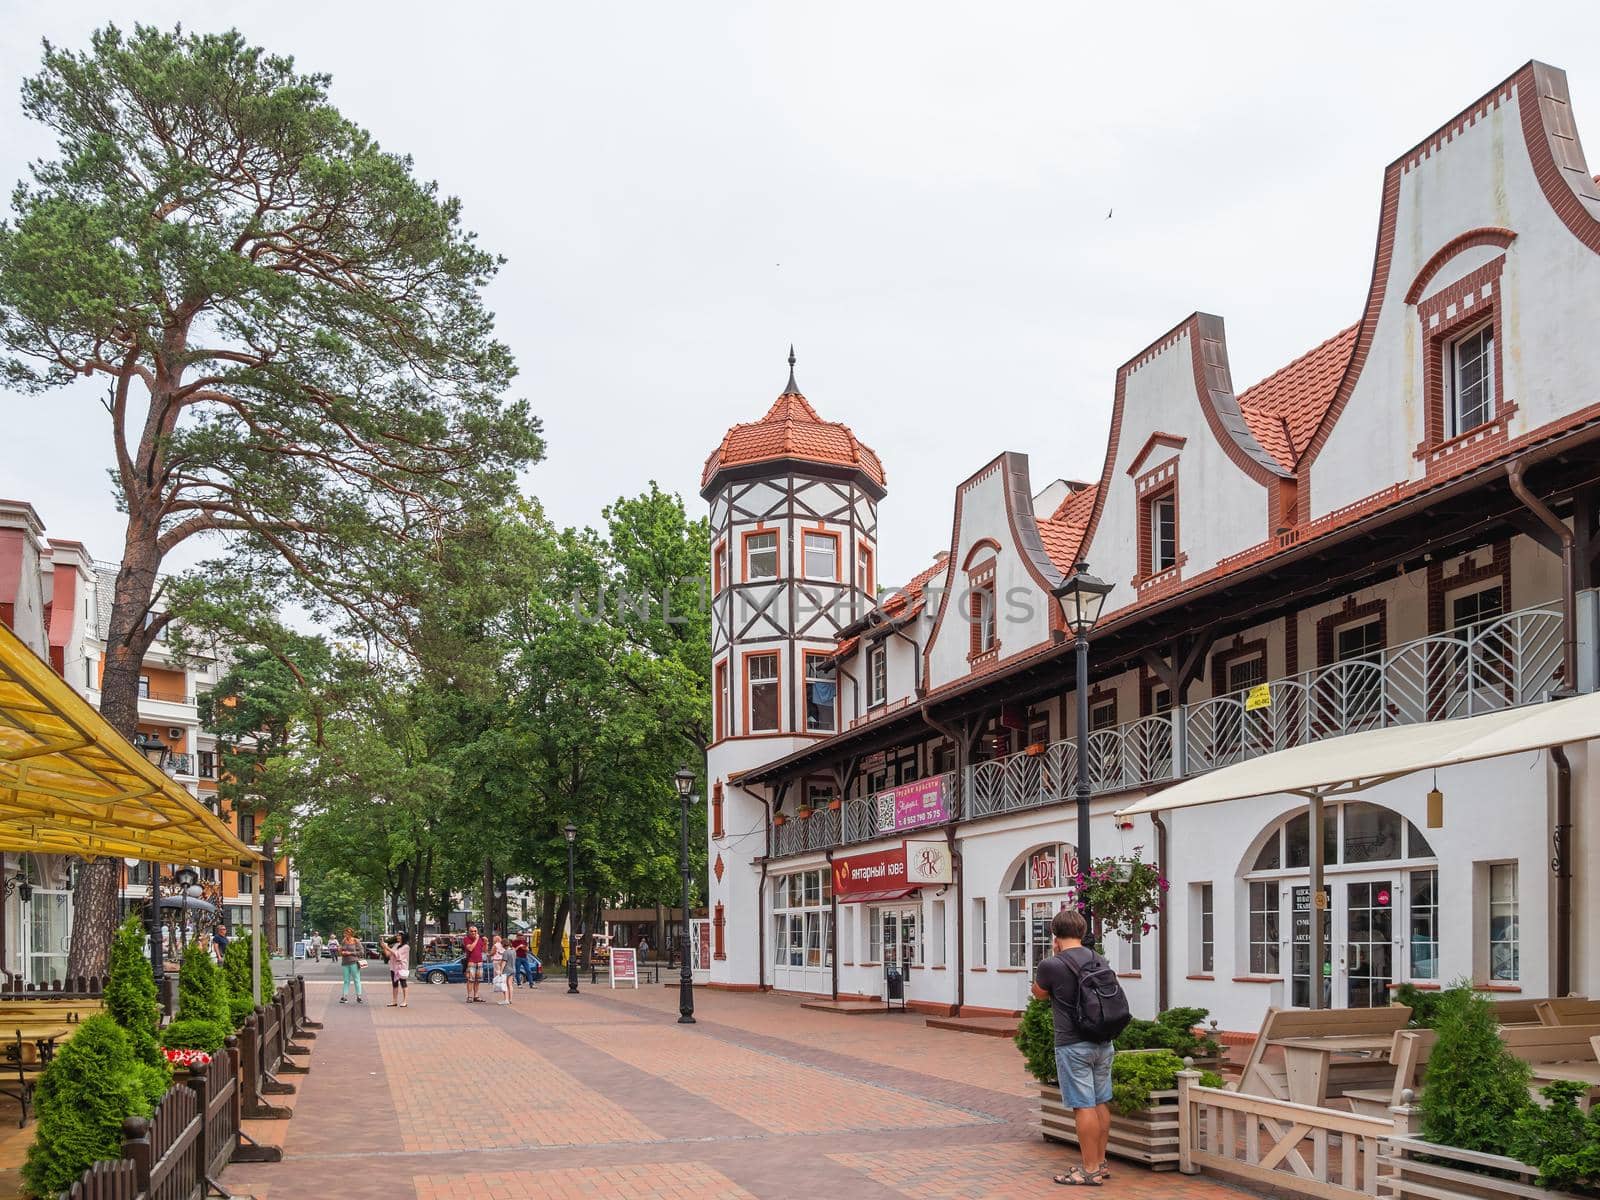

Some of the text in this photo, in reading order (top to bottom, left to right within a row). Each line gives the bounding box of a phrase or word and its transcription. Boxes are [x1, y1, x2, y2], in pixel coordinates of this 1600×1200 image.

[851, 862, 904, 882] янтарный юве
[1031, 852, 1078, 888] Арт Ле
